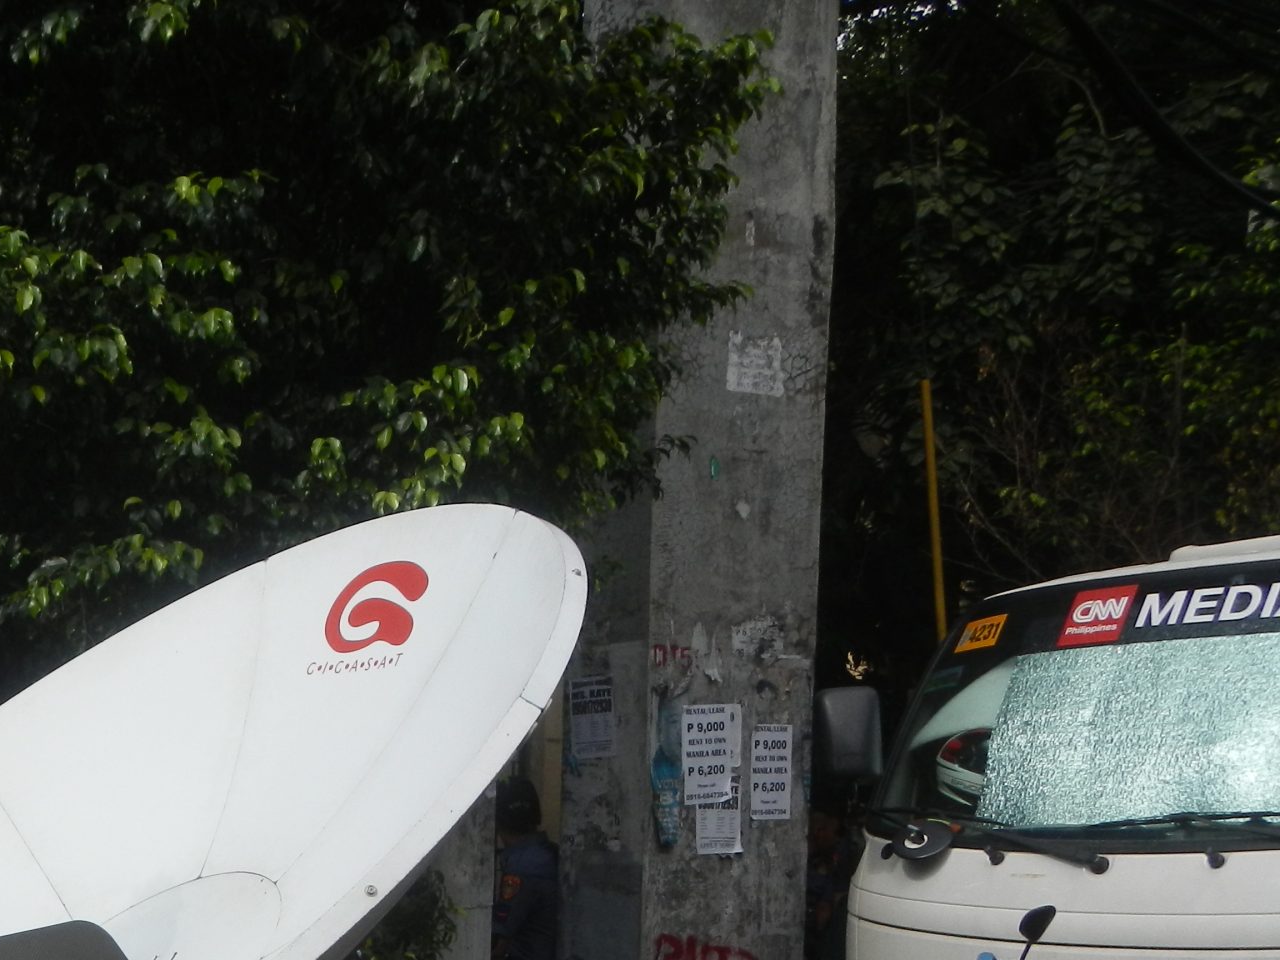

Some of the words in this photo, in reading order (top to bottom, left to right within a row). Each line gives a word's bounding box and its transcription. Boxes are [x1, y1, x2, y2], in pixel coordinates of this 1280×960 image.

[1072, 596, 1129, 623] CNN
[1134, 582, 1280, 628] MEDI
[1064, 625, 1118, 635] Philippines
[697, 721, 725, 734] 9,000
[763, 740, 787, 751] 9,000
[686, 750, 710, 758] MANILA
[711, 749, 727, 757] AREA
[698, 764, 725, 777] 6,200
[761, 782, 786, 793] 6,200
